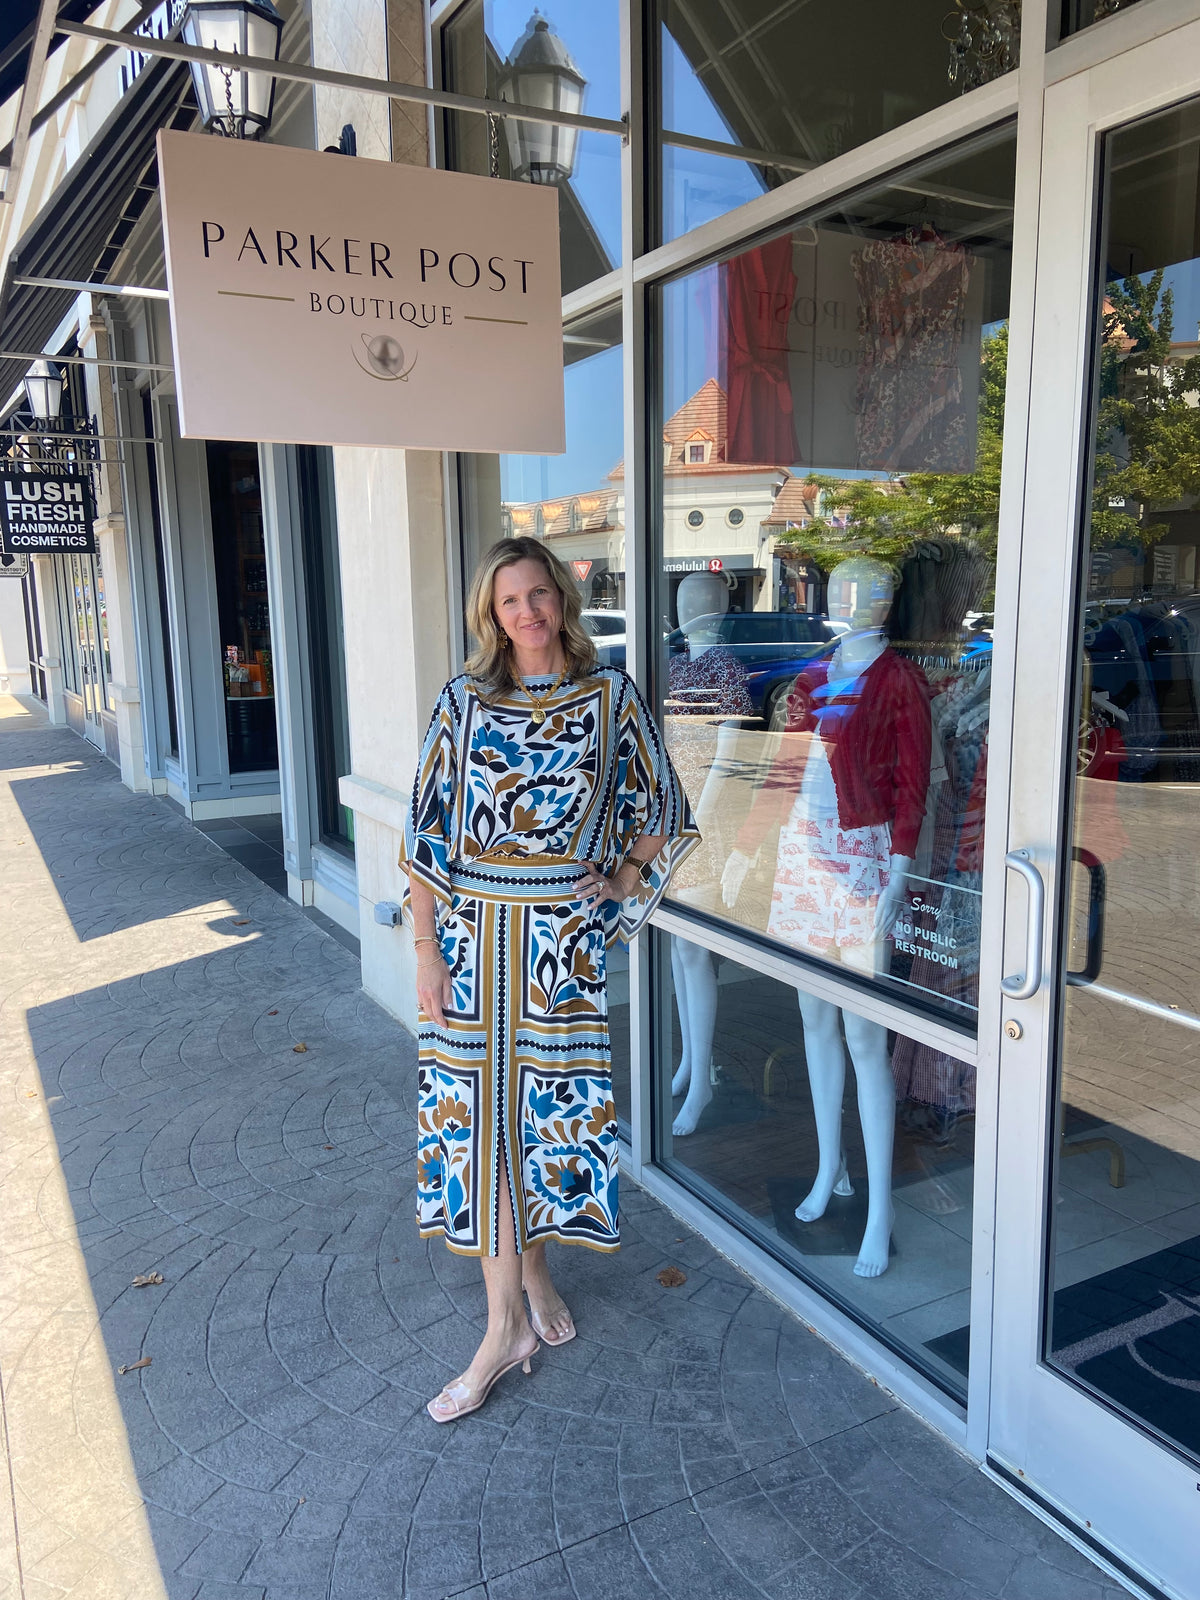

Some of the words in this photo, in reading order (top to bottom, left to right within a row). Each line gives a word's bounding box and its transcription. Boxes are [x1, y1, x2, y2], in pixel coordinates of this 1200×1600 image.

[201, 221, 394, 279] PARKER
[419, 248, 534, 294] POST
[309, 292, 453, 328] BOUTIQUE
[4, 481, 83, 502] LUSH
[7, 503, 85, 521] FRESH
[9, 523, 86, 534] HANDMADE
[11, 535, 88, 546] COSMETICS
[910, 897, 942, 920] Sorry
[895, 920, 911, 934] NO
[914, 926, 957, 949] PUBLIC
[895, 939, 958, 969] RESTROOM
